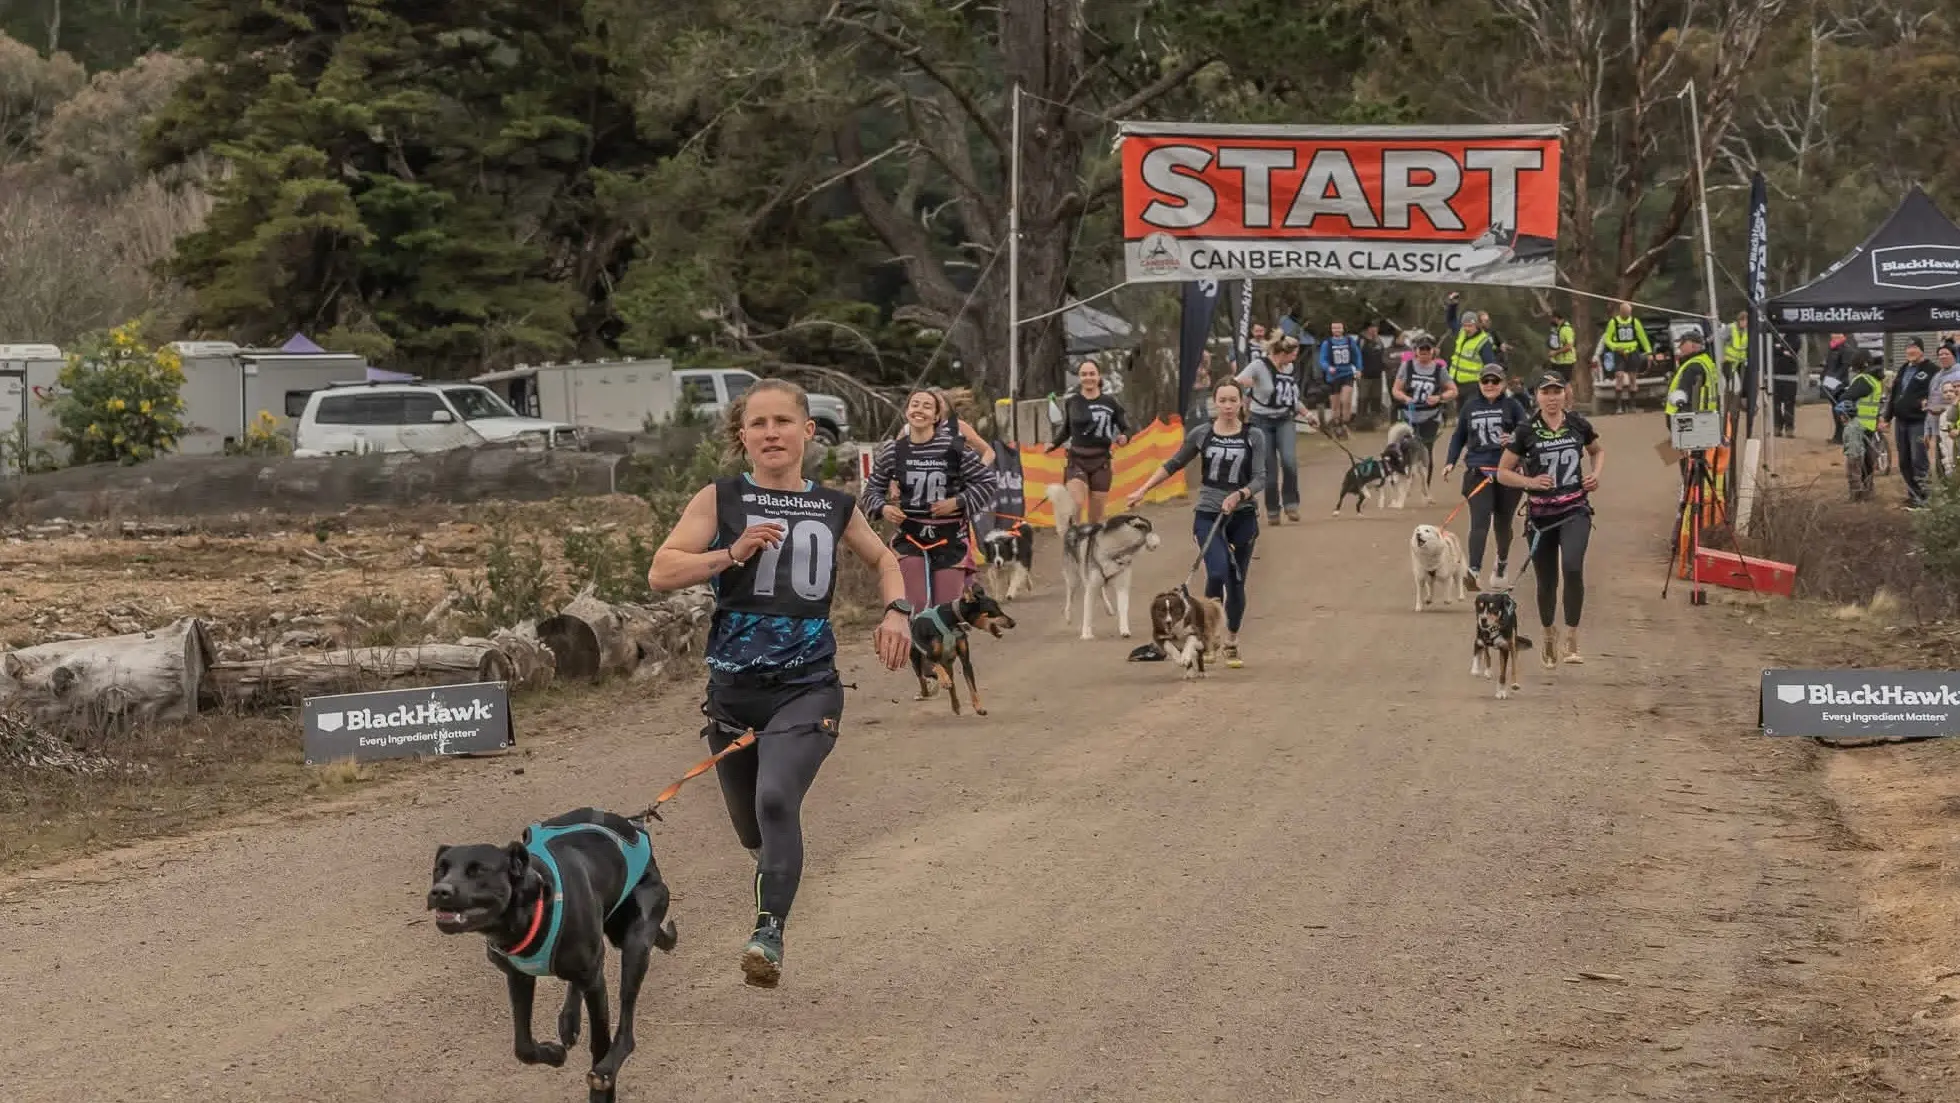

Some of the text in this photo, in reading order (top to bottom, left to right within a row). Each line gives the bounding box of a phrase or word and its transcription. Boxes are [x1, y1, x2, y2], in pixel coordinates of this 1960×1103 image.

[1140, 145, 1545, 232] START
[1189, 249, 1462, 273] CANBERRA CLASSIC
[1800, 307, 1884, 322] BlackHawk
[1471, 416, 1503, 446] 75
[1204, 446, 1245, 484] 77
[1540, 448, 1580, 488] 72
[757, 494, 832, 510] BlackHawk
[906, 470, 947, 506] 76
[746, 515, 834, 601] 70
[1807, 684, 1960, 706] BlackHawk
[346, 699, 492, 731] BlackHawk
[1822, 711, 1946, 723] Every Ingredient Matters
[359, 729, 477, 747] Every Ingredient Matters
